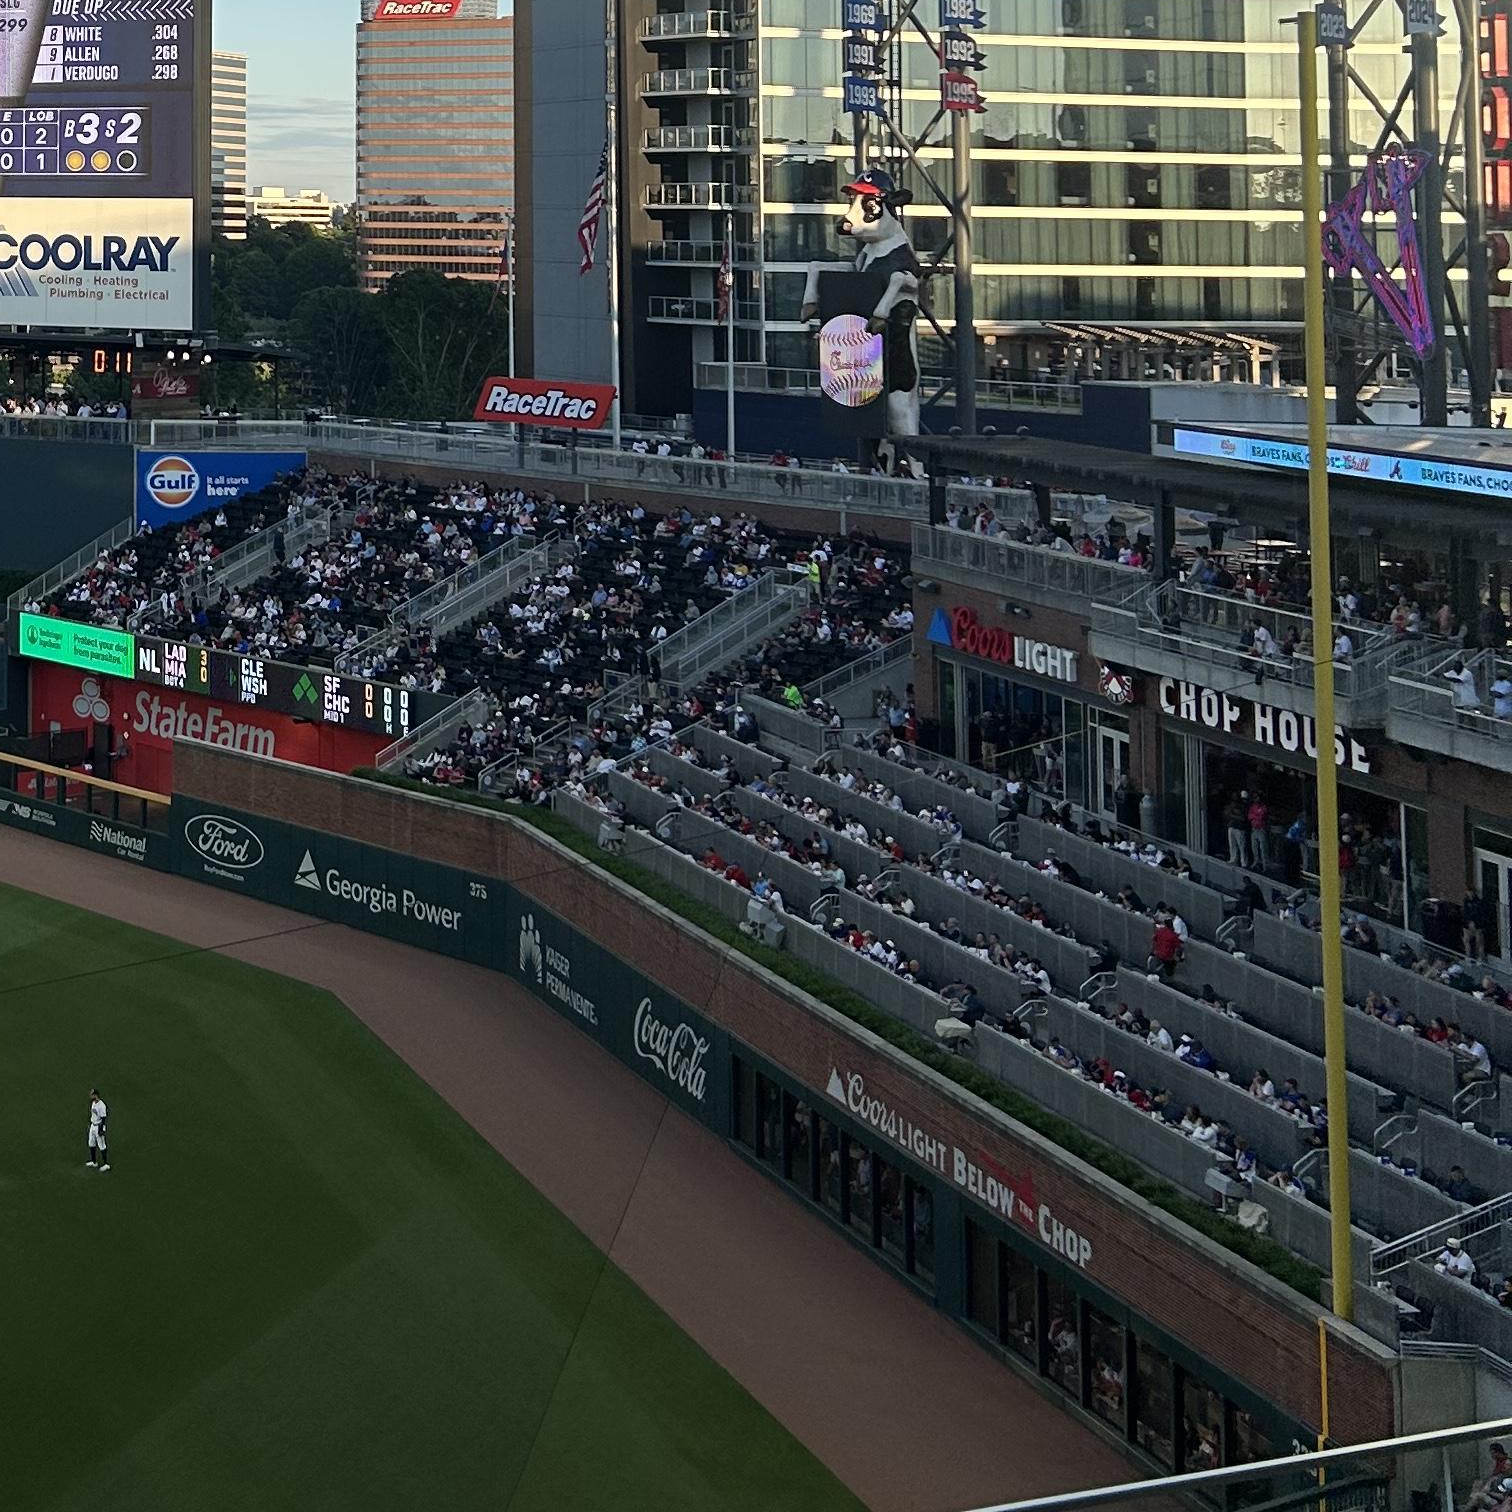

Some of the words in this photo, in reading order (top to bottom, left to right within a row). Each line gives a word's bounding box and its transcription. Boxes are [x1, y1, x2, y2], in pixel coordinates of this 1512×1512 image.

[52, 0, 80, 16] DUE
[382, 1, 453, 16] RaceTrac
[847, 4, 876, 24] 1969
[65, 26, 102, 42] WHITE
[151, 25, 178, 40] .304
[64, 46, 100, 62] ALLEN
[151, 45, 178, 60] .268
[945, 39, 975, 61] 1992
[64, 66, 118, 81] VERDUGO
[151, 64, 178, 80] .298
[848, 85, 876, 106] 1993
[28, 111, 54, 122] LOB
[76, 113, 101, 144] 3
[116, 112, 142, 144] 2
[39, 274, 83, 288] Cooling
[93, 274, 139, 288] Heating
[49, 288, 104, 301] Plumbing
[114, 288, 169, 301] Electrical
[484, 385, 597, 421] RaceTrac
[1251, 445, 1280, 461] BRAVES
[149, 473, 196, 490] Gulf
[215, 476, 225, 485] all
[226, 477, 249, 485] starts
[1421, 467, 1456, 484] BRAVES
[207, 485, 238, 496] here
[164, 642, 187, 662] LAD
[950, 606, 1013, 664] Coors
[1013, 635, 1078, 682] LIGHT
[139, 647, 161, 674] NL
[164, 659, 187, 678] MIA
[241, 658, 264, 678] CLE
[241, 674, 268, 696] WSH
[324, 675, 341, 693] SF
[324, 694, 350, 714] CHC
[1159, 676, 1241, 733] CHOP
[1254, 702, 1371, 774] HOUSE
[102, 826, 147, 852] National
[199, 820, 251, 862] Ford
[326, 869, 397, 913] Georgia
[402, 889, 462, 931] Power
[469, 882, 488, 900] 375
[633, 997, 711, 1102] Coca-Cola
[846, 1071, 897, 1138] Coors
[898, 1122, 947, 1174] LIGHT
[1038, 1203, 1093, 1269] CHOP
